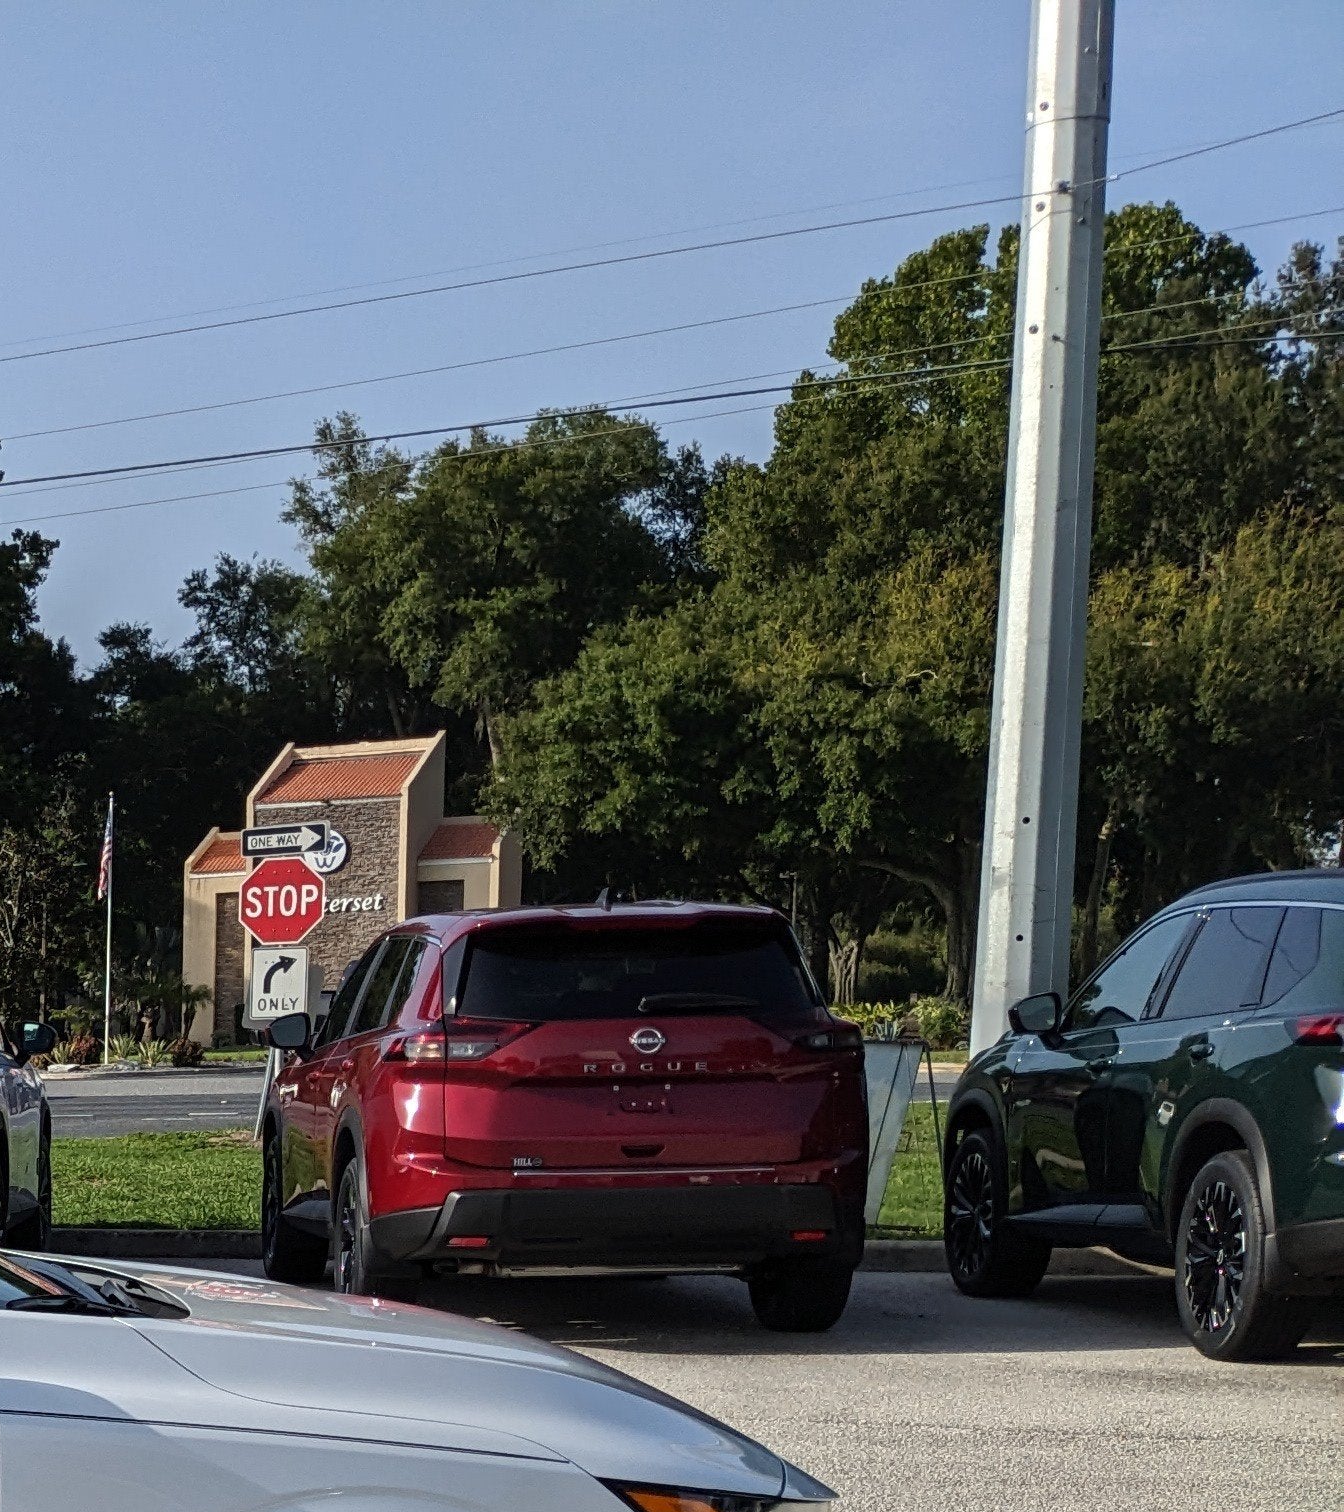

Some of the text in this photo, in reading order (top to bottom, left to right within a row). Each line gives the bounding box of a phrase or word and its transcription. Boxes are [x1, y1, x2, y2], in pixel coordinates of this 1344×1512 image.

[250, 833, 301, 848] ONE WAY
[245, 884, 319, 918] STOP
[257, 997, 299, 1012] ONLY
[583, 1061, 708, 1074] ROGUE
